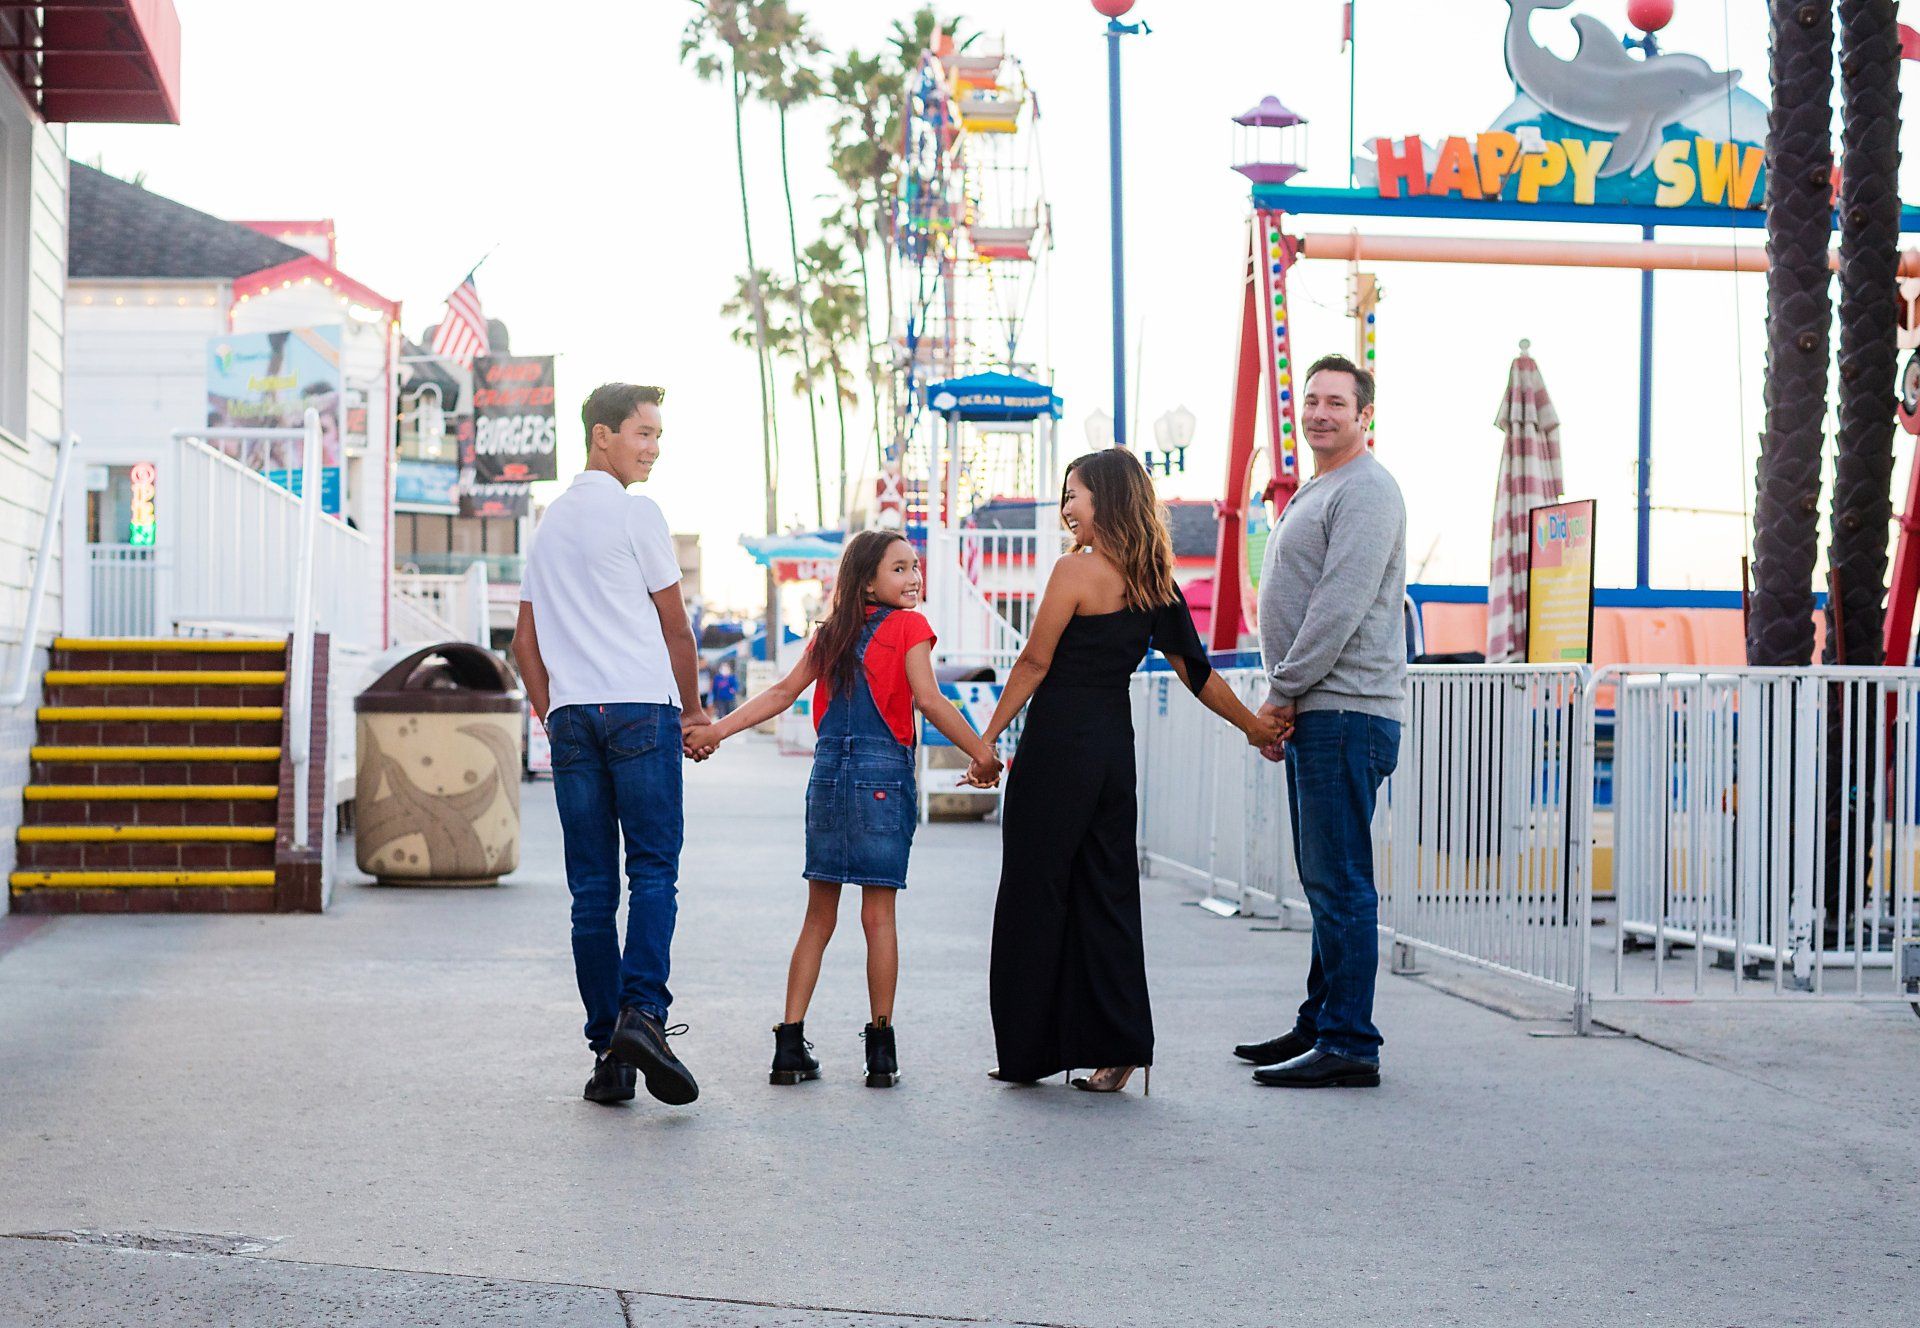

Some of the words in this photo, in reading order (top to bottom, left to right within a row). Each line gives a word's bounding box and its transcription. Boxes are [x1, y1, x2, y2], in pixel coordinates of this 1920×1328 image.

[1376, 131, 1613, 205] HAPPY
[1653, 137, 1766, 209] SW
[475, 415, 556, 455] BURGERS
[1549, 513, 1567, 540] Did
